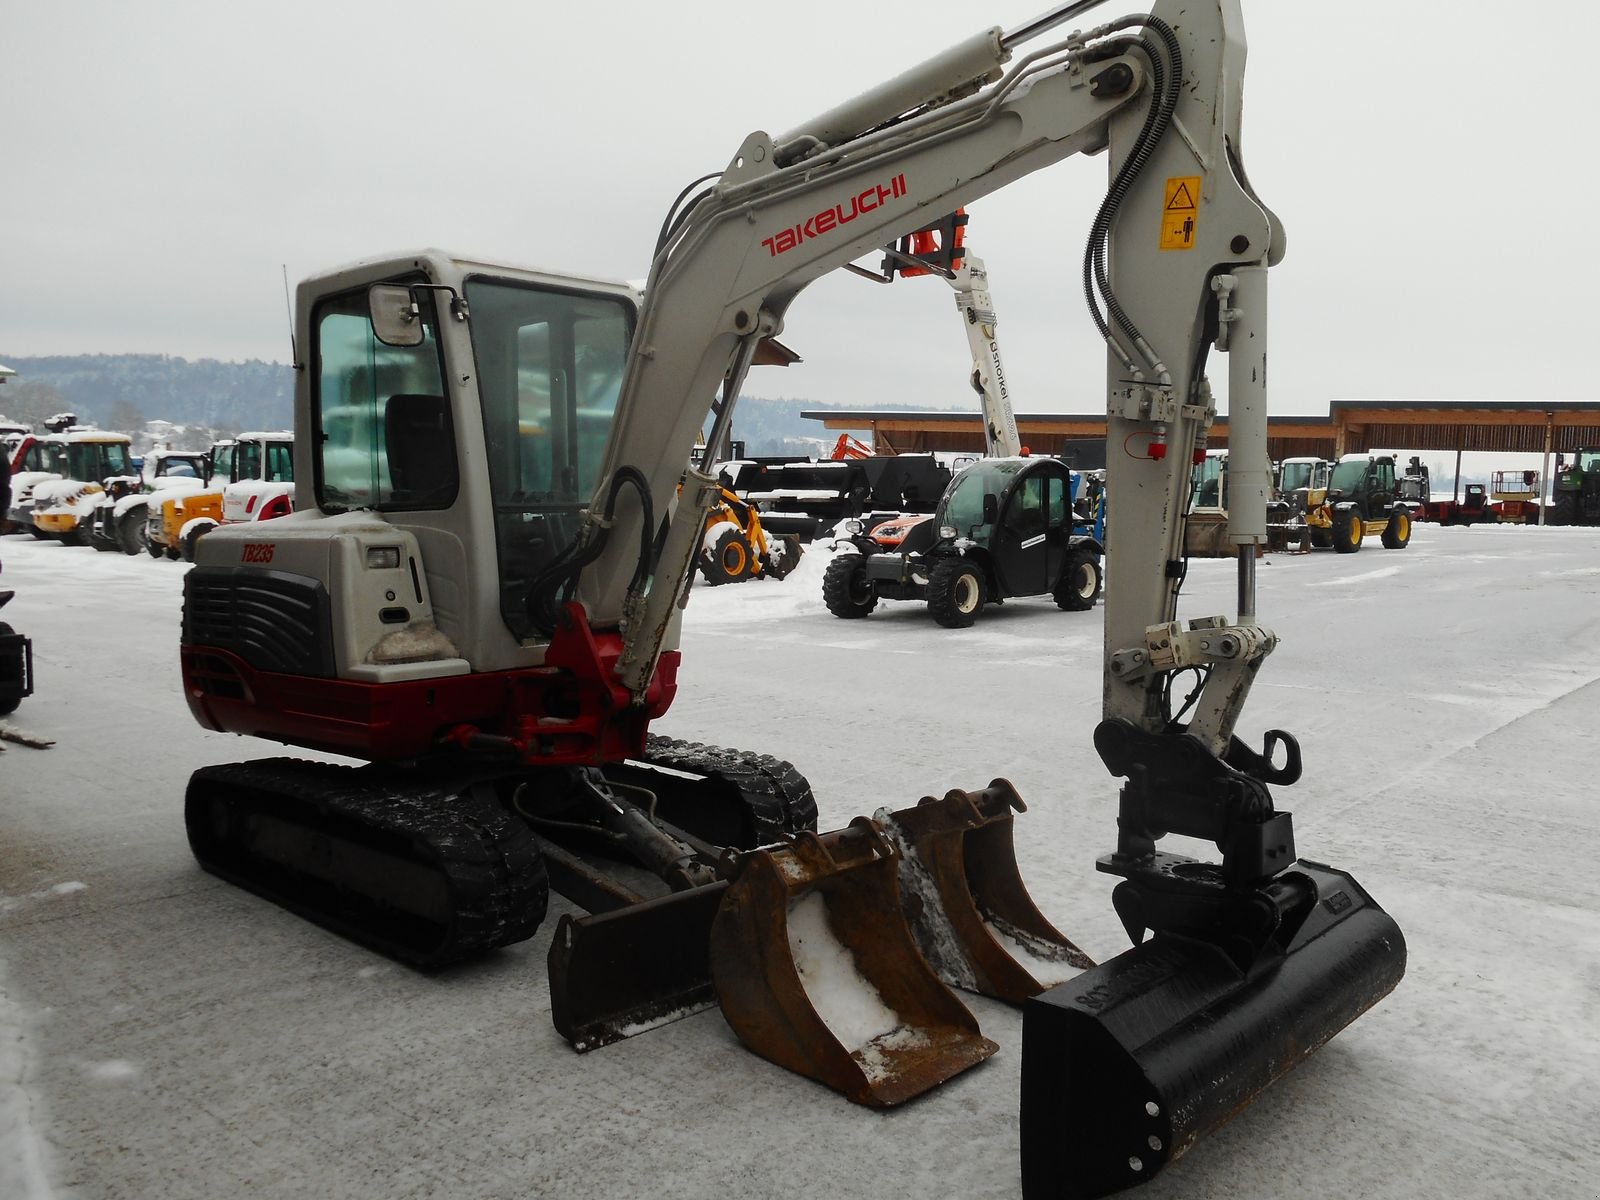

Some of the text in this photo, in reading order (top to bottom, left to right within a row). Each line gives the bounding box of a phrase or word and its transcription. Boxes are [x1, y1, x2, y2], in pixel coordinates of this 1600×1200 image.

[761, 173, 907, 257] TAKEUCHI
[992, 352, 1008, 400] snorkel
[240, 543, 276, 563] TB235
